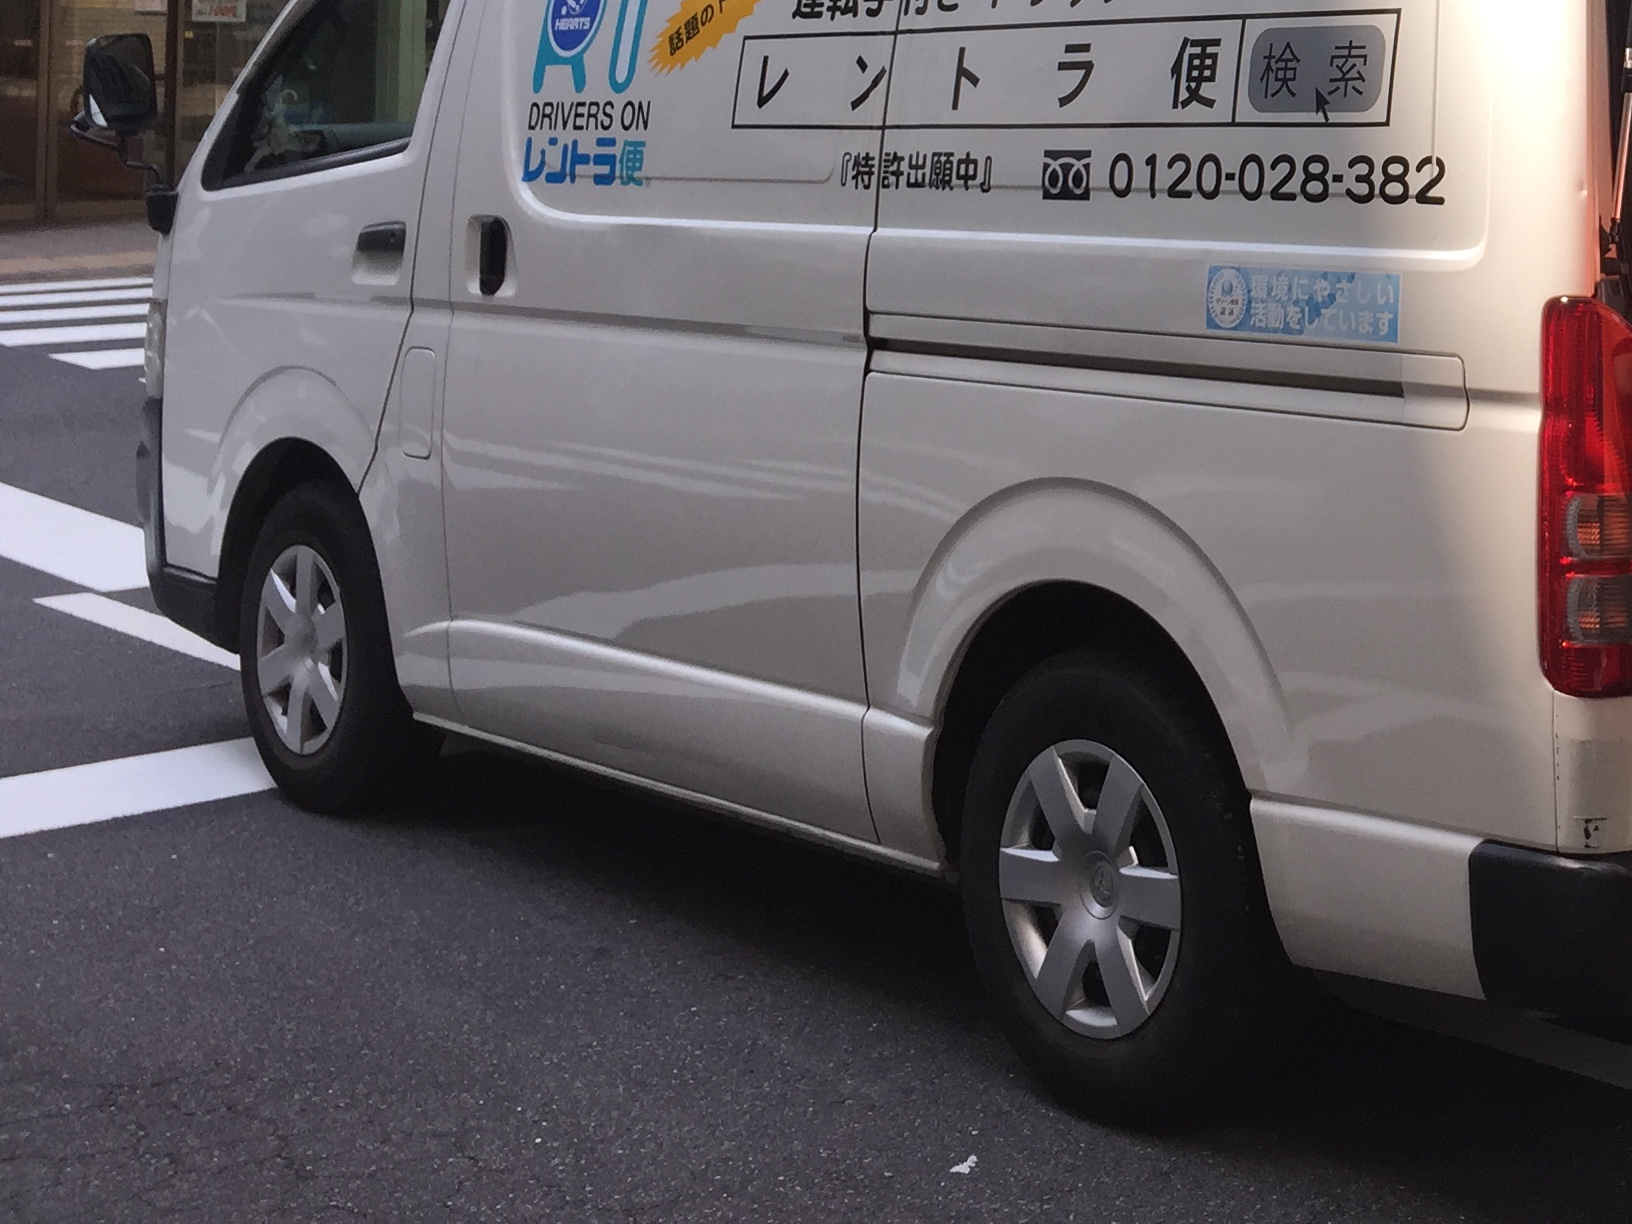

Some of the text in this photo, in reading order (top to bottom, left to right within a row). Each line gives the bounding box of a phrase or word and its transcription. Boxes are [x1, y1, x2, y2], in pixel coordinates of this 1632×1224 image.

[1260, 40, 1370, 100] 検索
[527, 100, 651, 131] DRIVERS ON
[521, 136, 646, 186] レントラ便
[841, 151, 1446, 206] 『特許出願中』 0120-028-382
[1251, 274, 1395, 305] 環境にやさしい
[1251, 302, 1394, 335] 活動をしています
